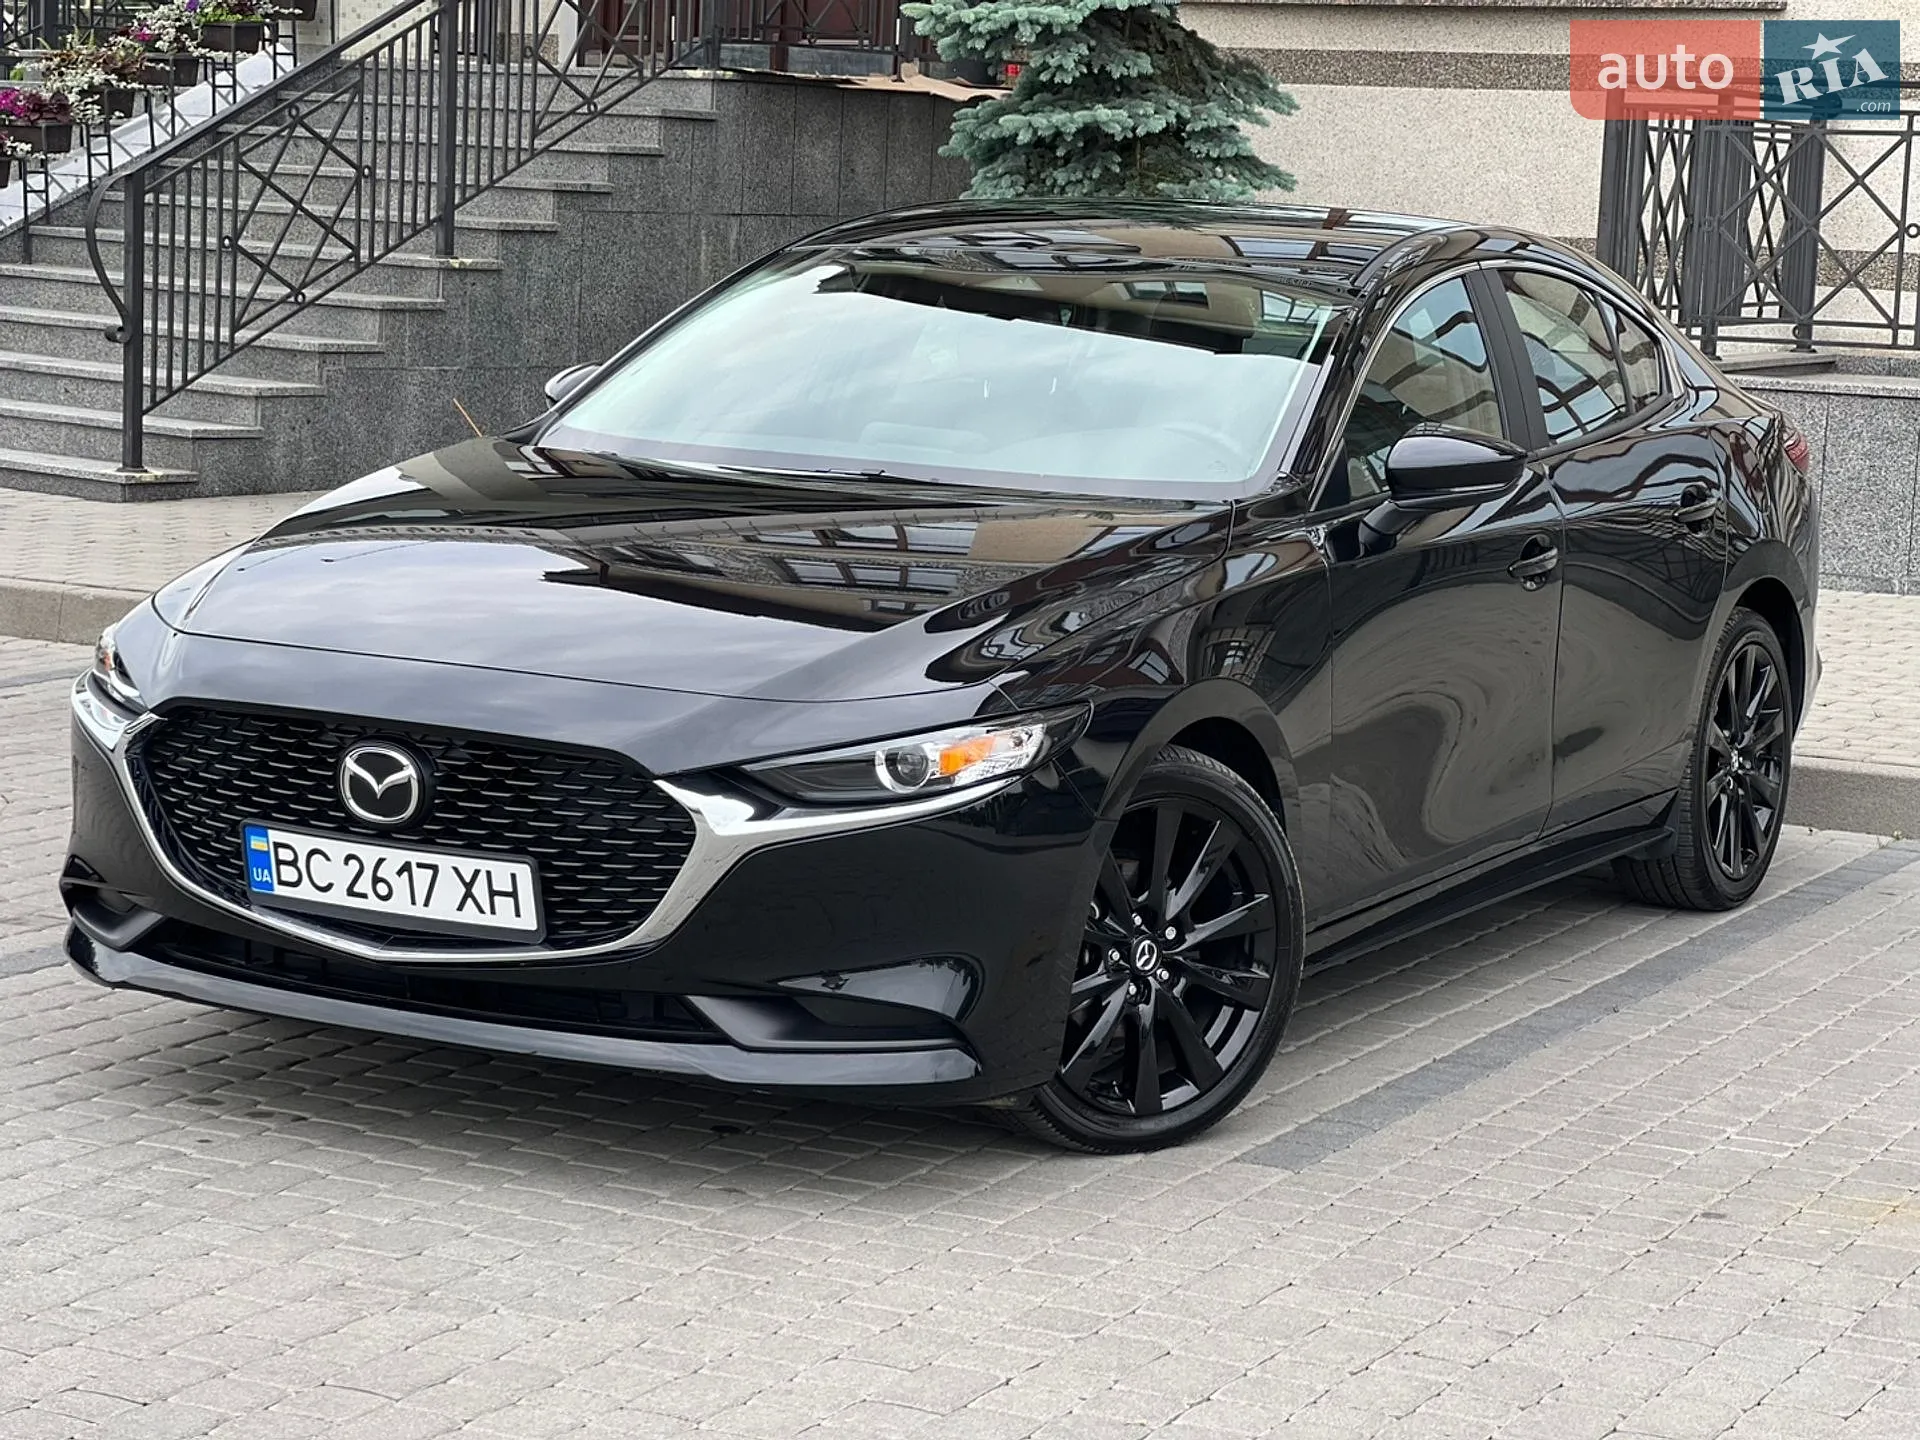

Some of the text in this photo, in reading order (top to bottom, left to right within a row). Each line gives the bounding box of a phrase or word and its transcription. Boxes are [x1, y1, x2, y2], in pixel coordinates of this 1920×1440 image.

[253, 867, 272, 884] UA
[272, 841, 522, 918] BC 2617 XH
